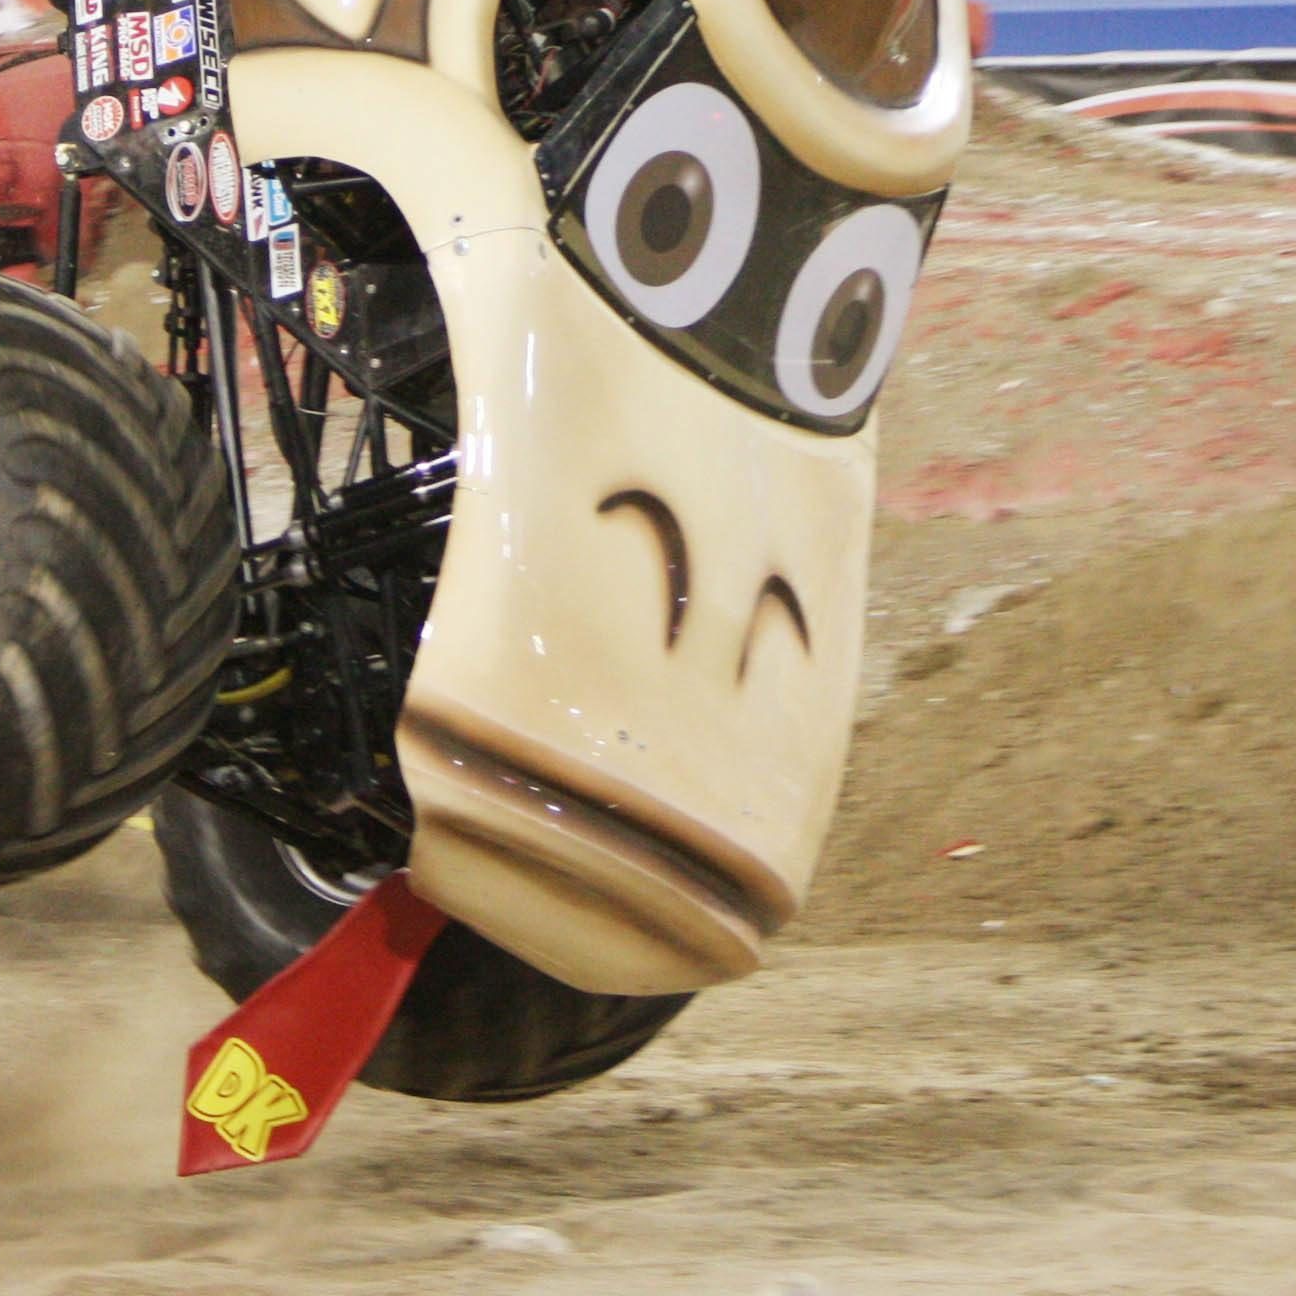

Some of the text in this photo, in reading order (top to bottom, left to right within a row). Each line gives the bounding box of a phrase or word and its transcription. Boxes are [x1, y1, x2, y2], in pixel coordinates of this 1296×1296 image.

[90, 24, 110, 87] KING
[129, 14, 149, 77] MSD
[250, 171, 265, 211] AWK
[187, 1037, 309, 1162] DK
